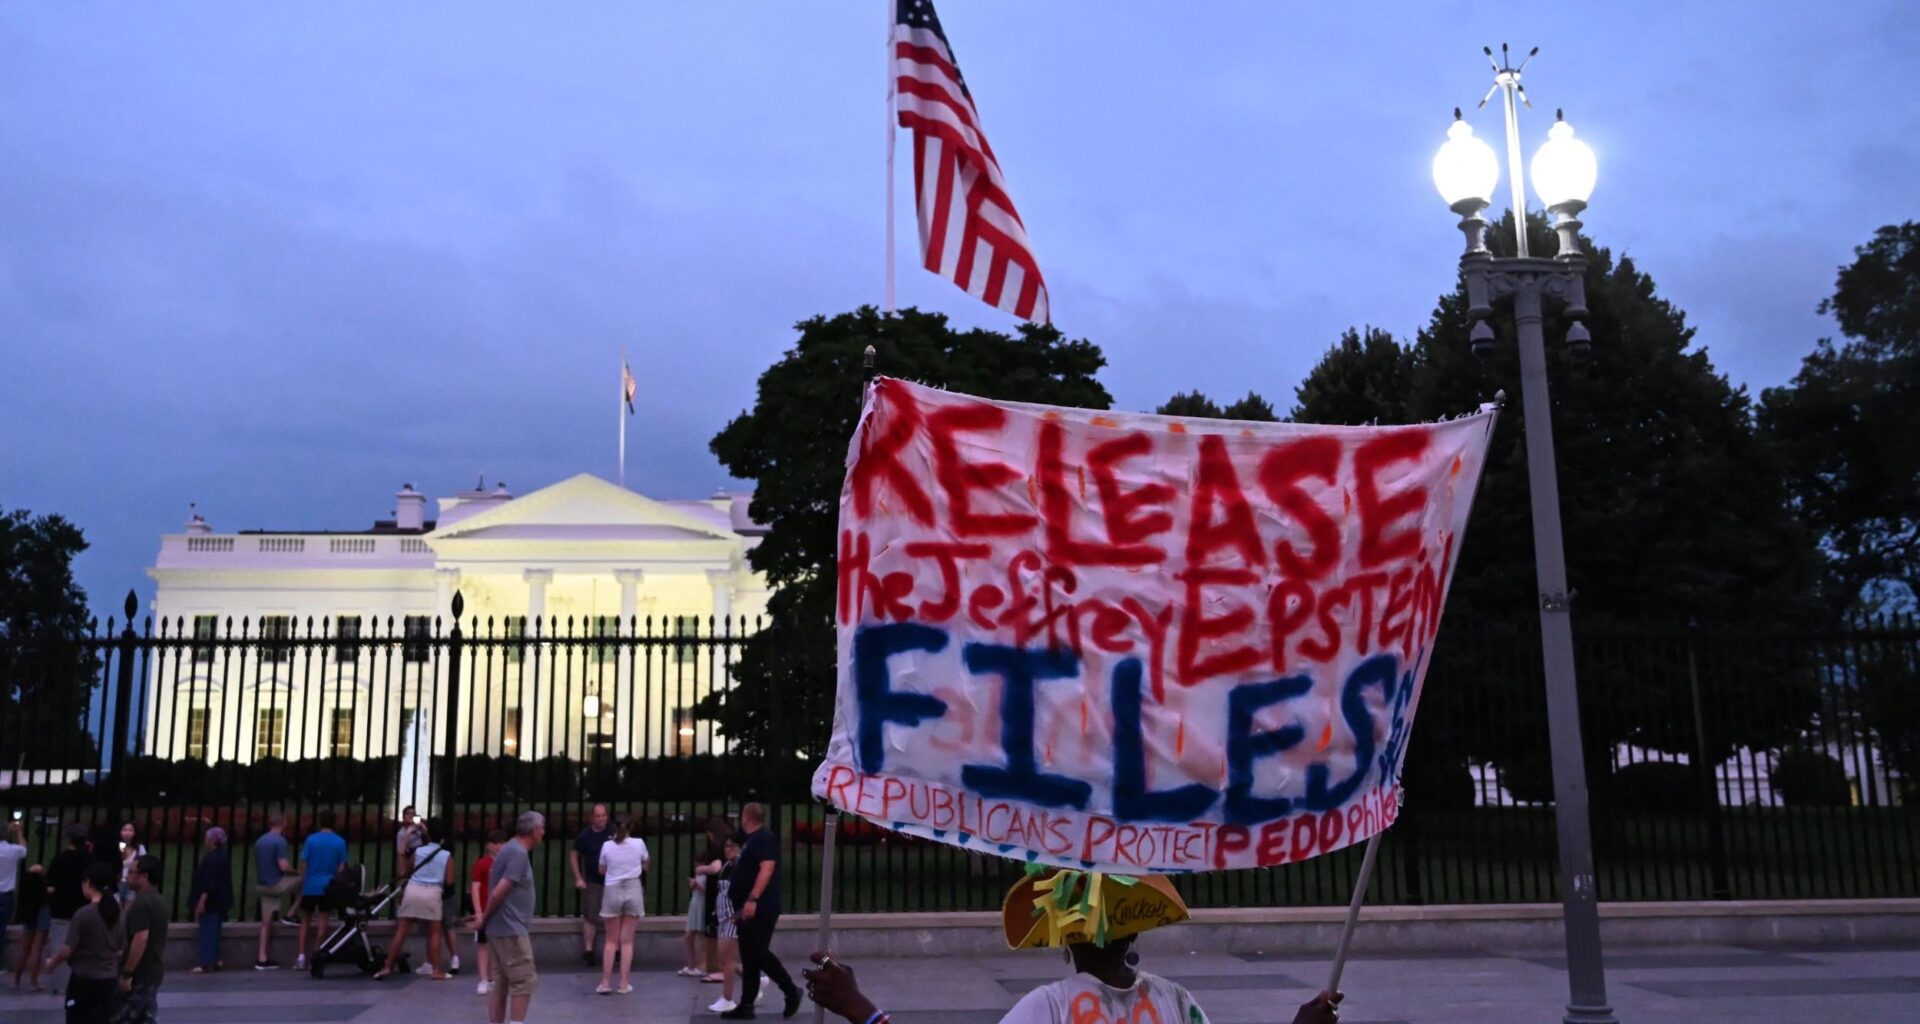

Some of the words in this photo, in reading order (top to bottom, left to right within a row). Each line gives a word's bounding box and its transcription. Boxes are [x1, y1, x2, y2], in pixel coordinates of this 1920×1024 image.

[853, 377, 1429, 581] RELEASE
[837, 529, 915, 626] the
[905, 543, 1173, 705] Jeffrey
[1174, 531, 1454, 686] EPSTEIN
[826, 765, 1073, 855] REPUBLICANS
[1081, 816, 1218, 867] PROTECT
[854, 623, 1398, 825] FILES
